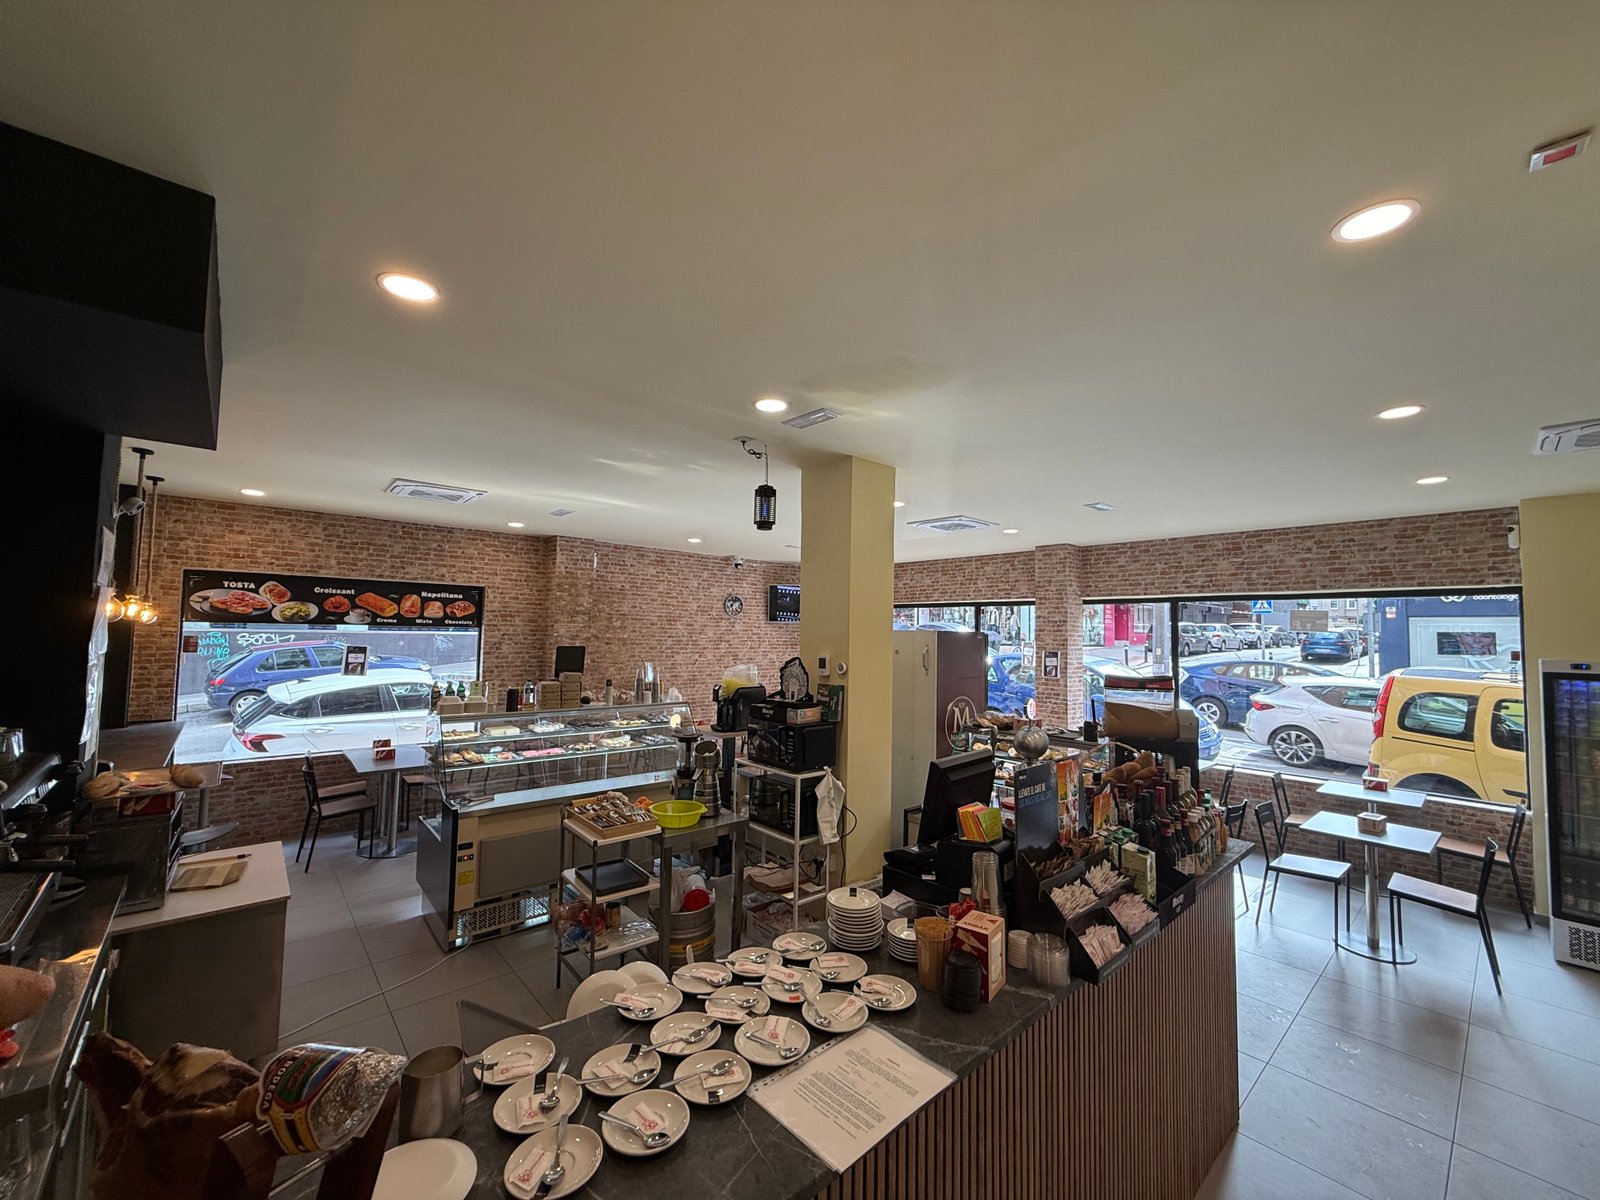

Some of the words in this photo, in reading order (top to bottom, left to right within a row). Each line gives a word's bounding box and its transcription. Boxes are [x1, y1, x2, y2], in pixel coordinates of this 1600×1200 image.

[222, 580, 256, 589] TOSTA
[314, 587, 355, 595] Croissant
[421, 591, 463, 599] Napolitana
